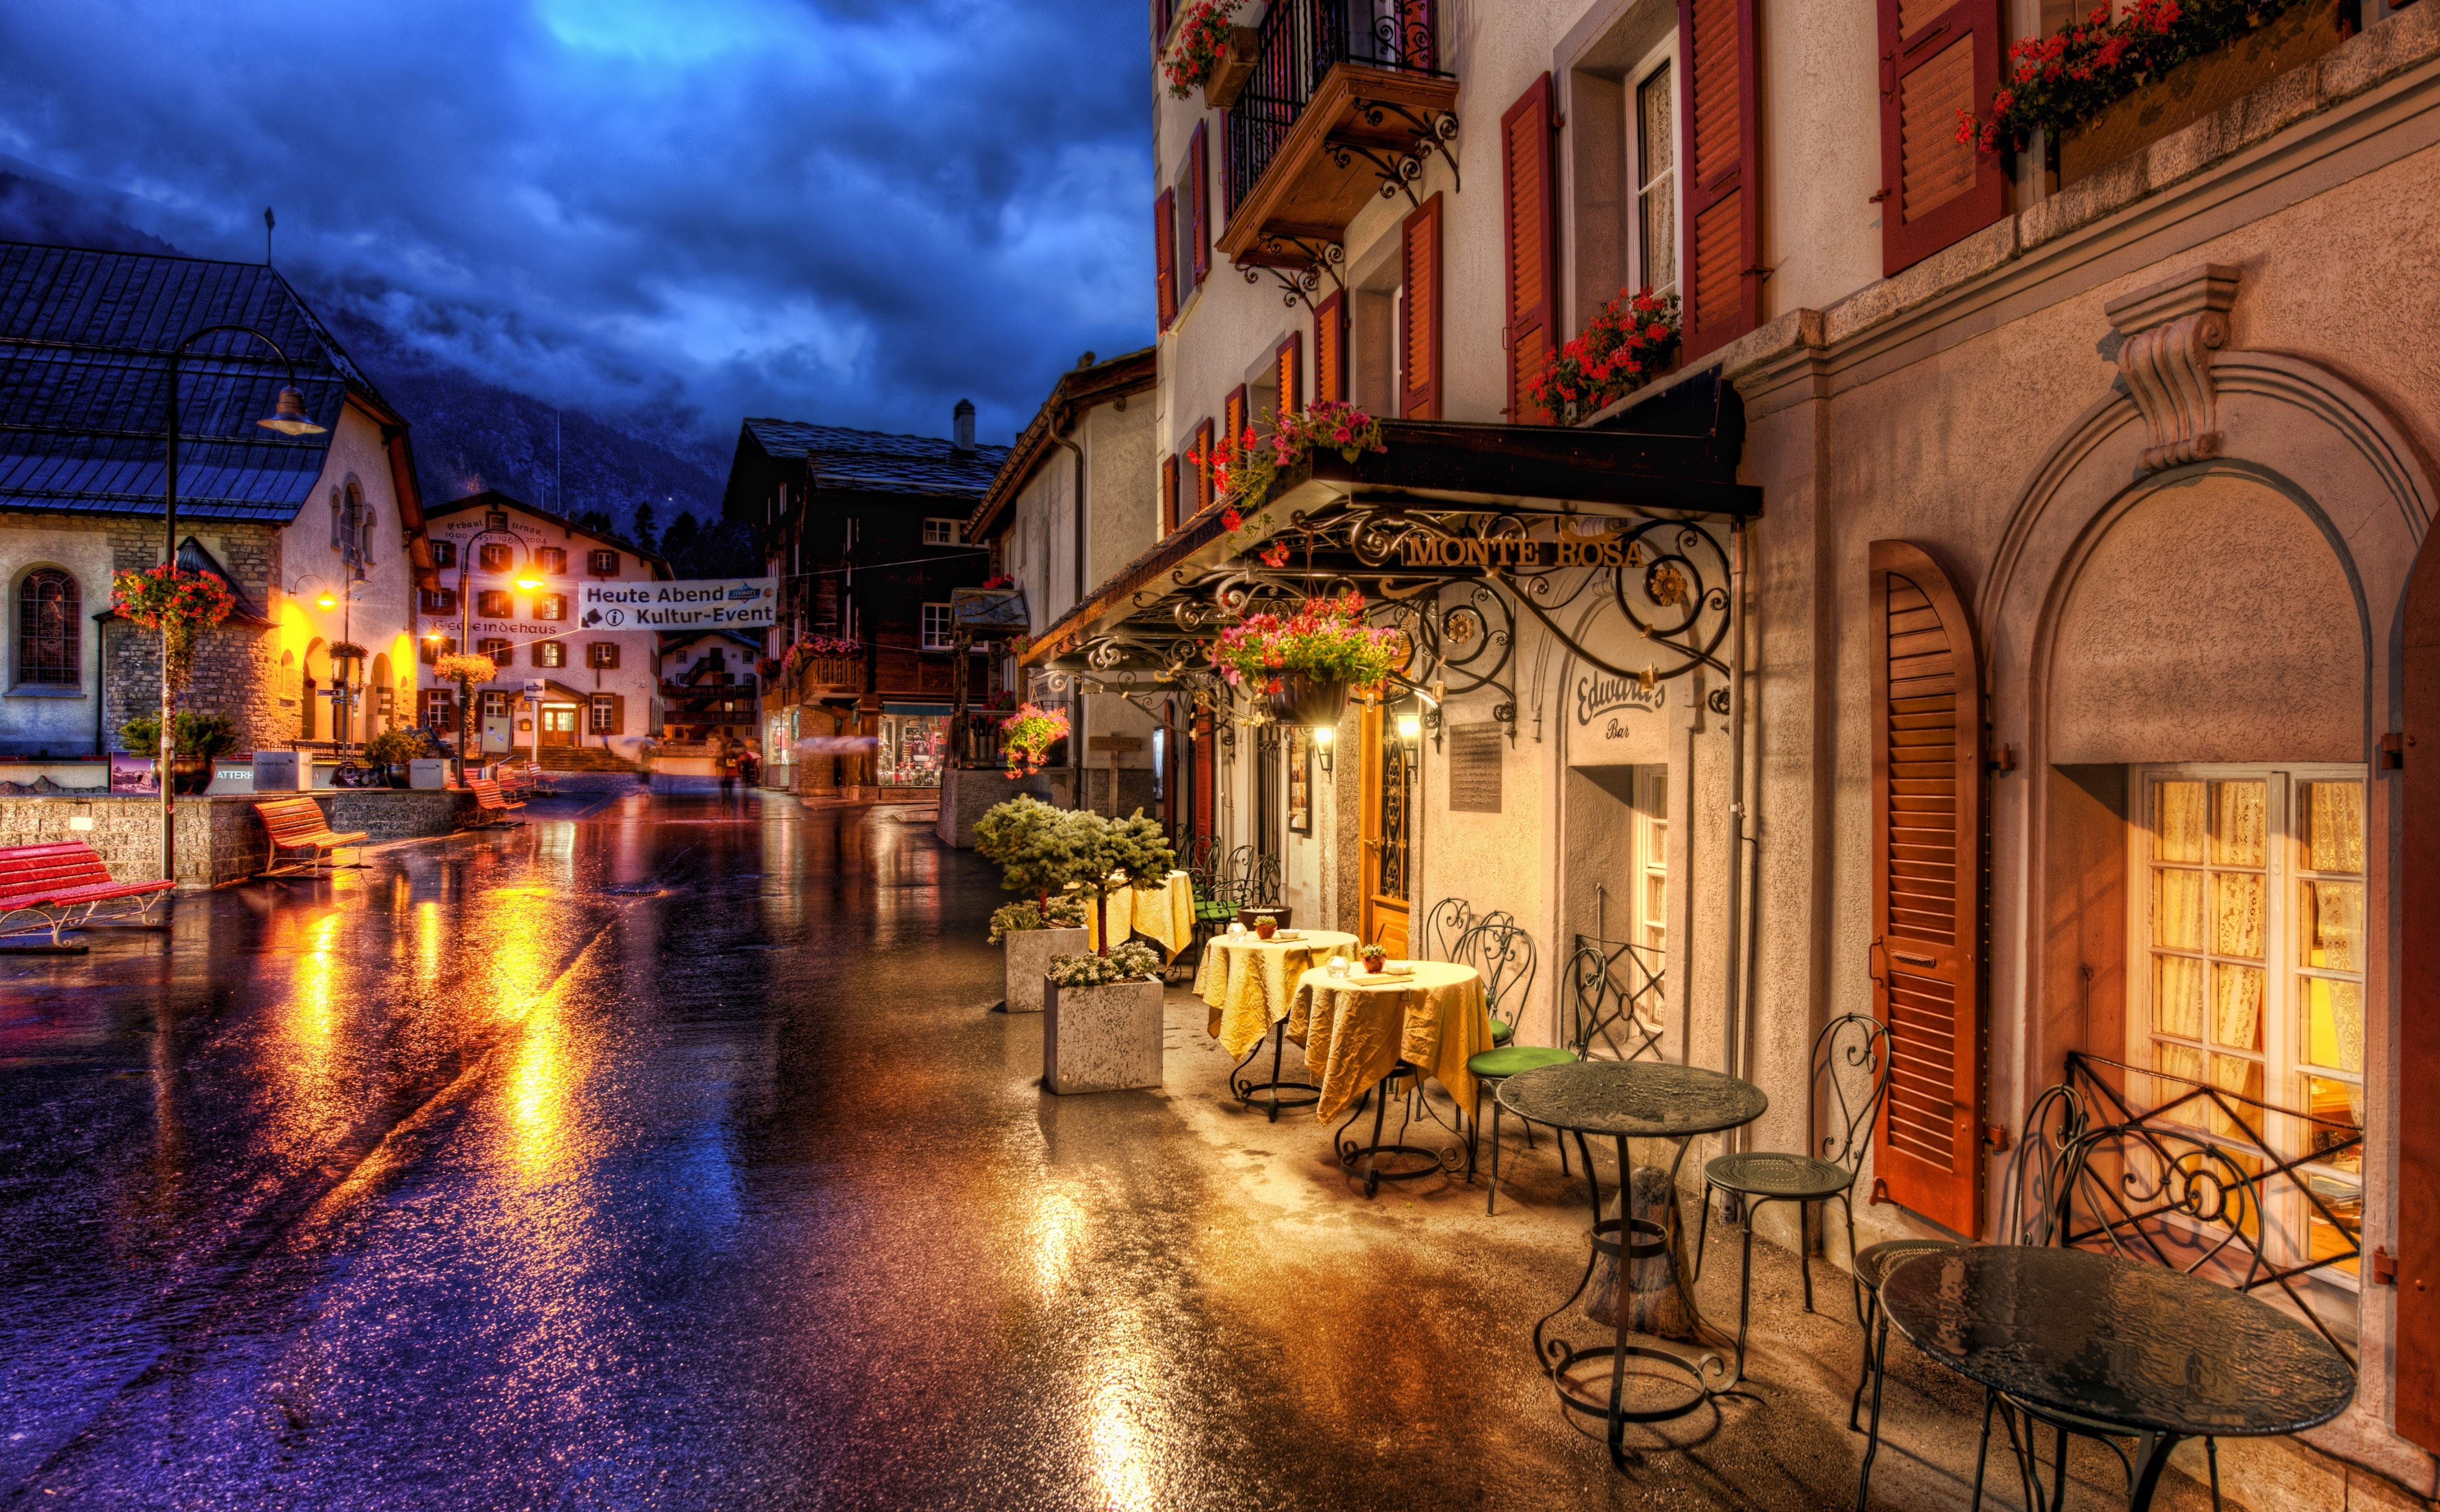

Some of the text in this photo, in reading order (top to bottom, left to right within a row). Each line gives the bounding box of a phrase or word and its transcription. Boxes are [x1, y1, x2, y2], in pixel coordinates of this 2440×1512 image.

[447, 519, 483, 530] Erbaut
[1407, 537, 1647, 568] MONTE ROSA
[587, 586, 724, 603] Heute Abend
[637, 606, 773, 624] Kultur-Event
[1606, 718, 1630, 740] Bar
[215, 771, 254, 779] ATTERH
